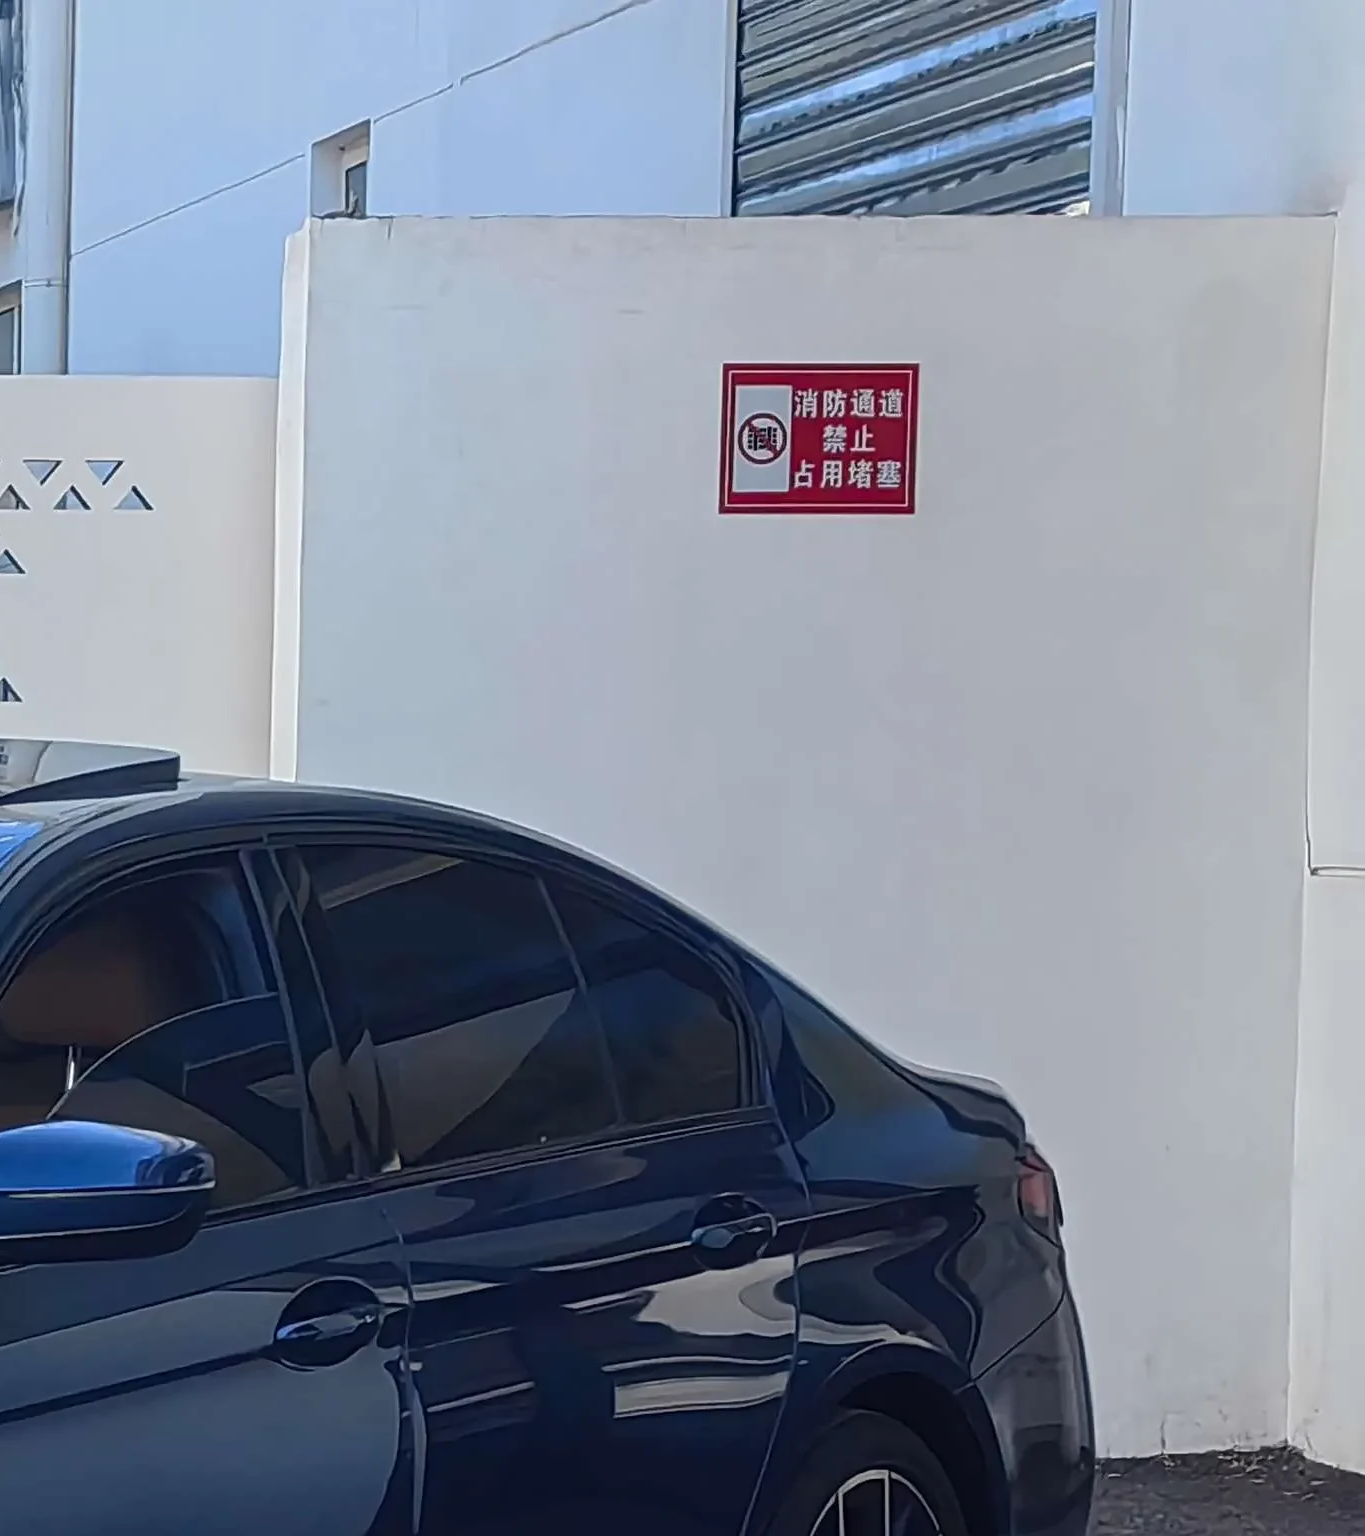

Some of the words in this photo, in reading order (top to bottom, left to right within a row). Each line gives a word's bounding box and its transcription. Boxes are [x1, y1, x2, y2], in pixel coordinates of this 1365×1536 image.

[794, 388, 903, 418] 消防通道
[822, 424, 876, 453] 禁止
[793, 459, 901, 489] 占用堵塞
